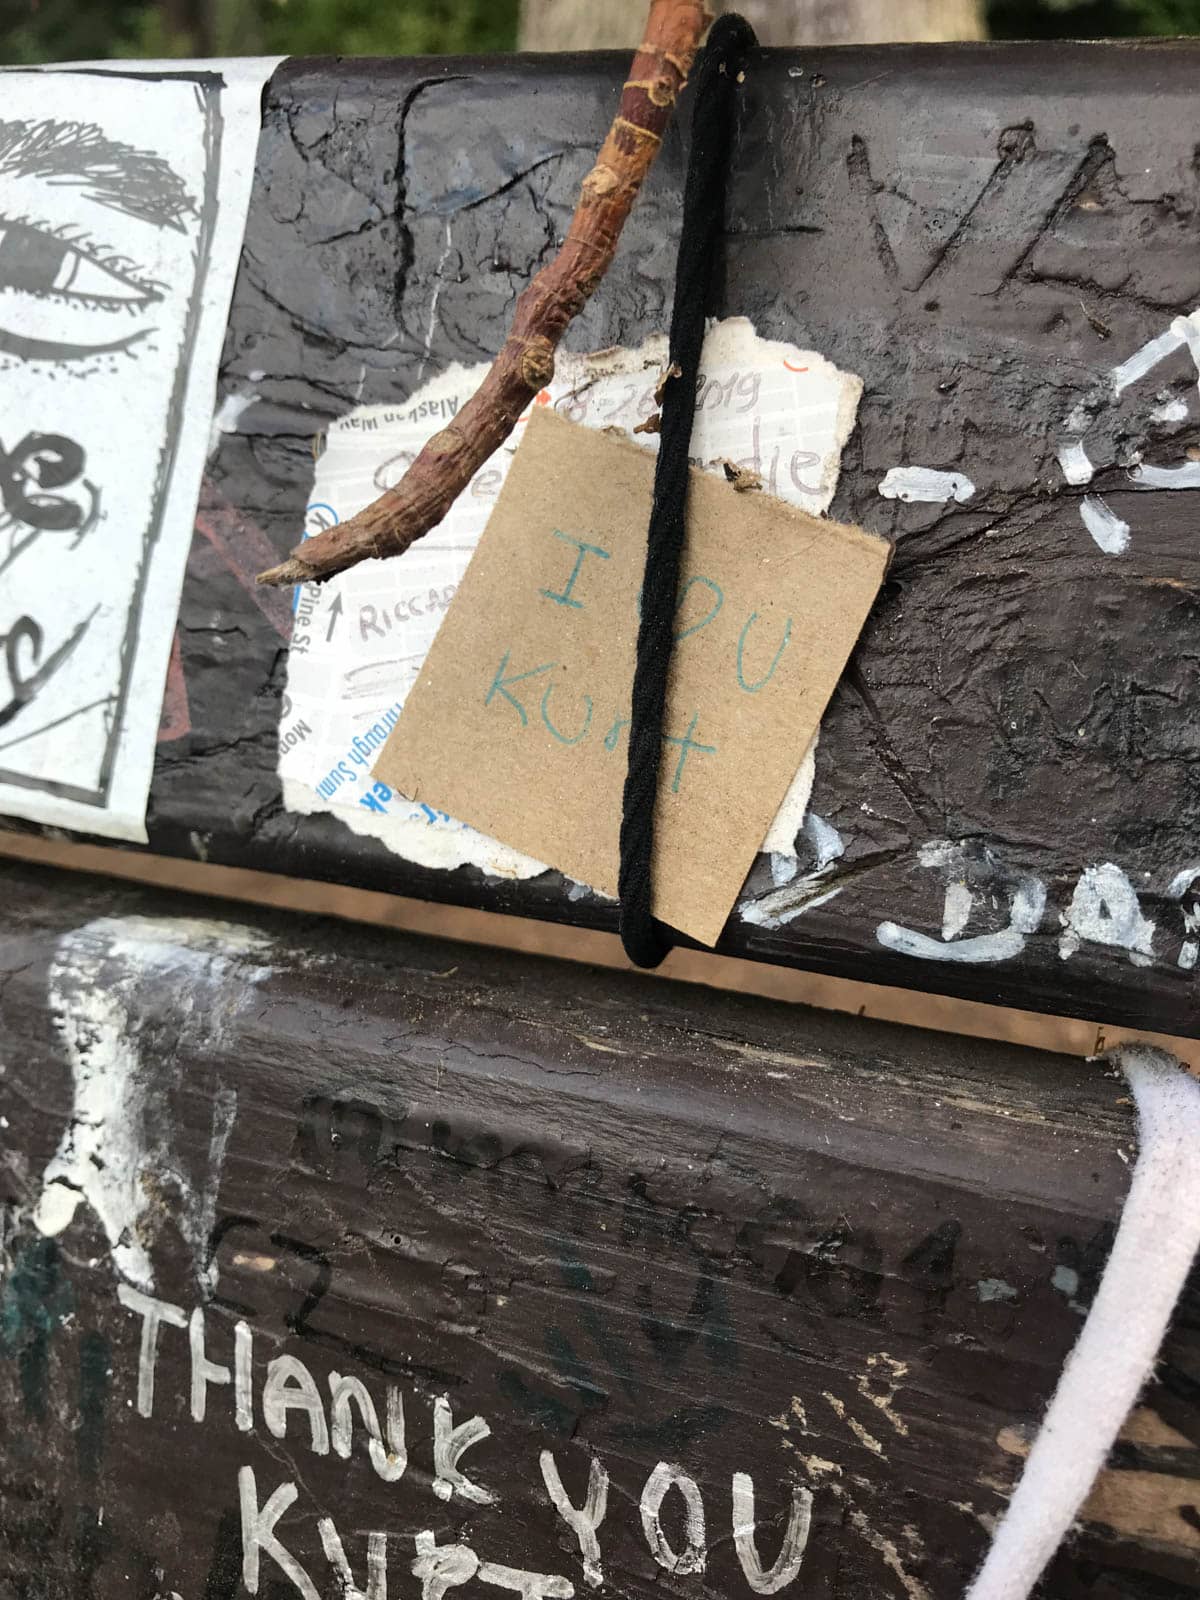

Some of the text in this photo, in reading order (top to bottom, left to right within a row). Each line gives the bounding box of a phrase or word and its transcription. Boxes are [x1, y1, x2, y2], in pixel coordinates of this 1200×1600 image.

[291, 582, 322, 655] Pine St
[538, 528, 794, 693] I U
[359, 780, 393, 814] ek
[117, 1283, 815, 1596] THANK YOU
